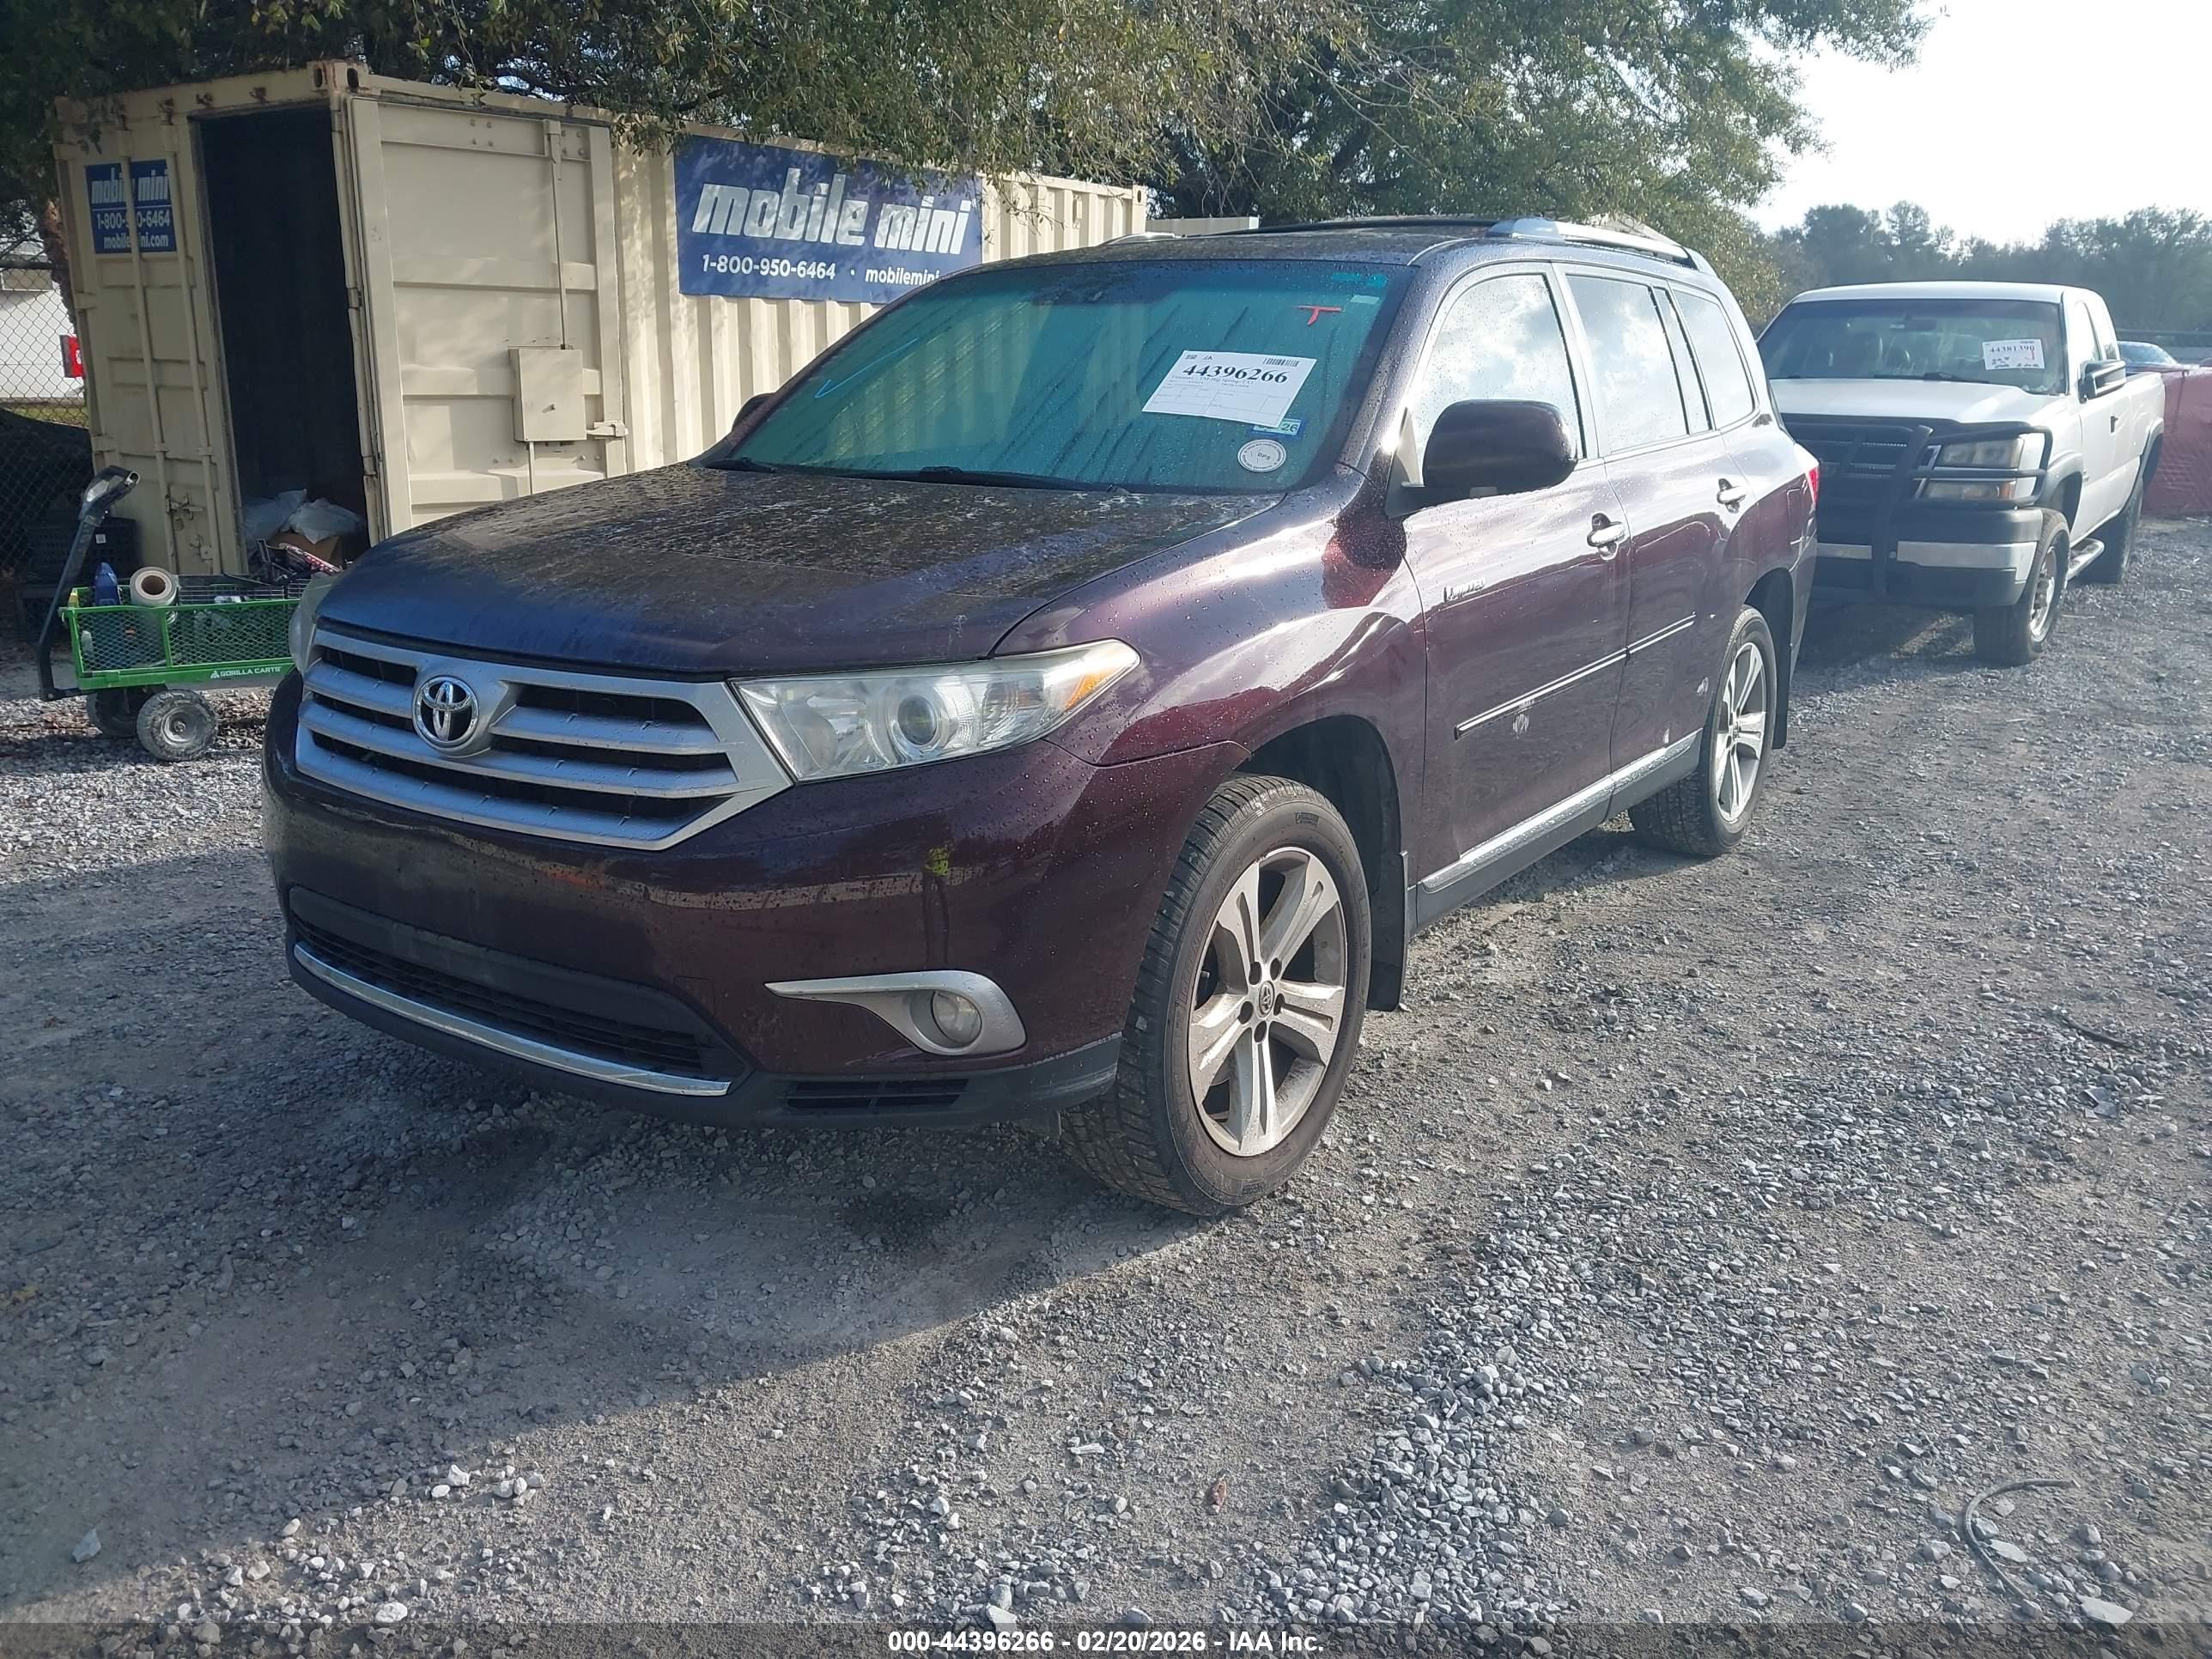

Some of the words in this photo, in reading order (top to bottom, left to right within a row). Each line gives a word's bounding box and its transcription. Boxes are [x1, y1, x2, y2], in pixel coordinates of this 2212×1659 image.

[137, 169, 169, 201] mini
[692, 167, 869, 246] mobile
[874, 195, 970, 254] mini
[702, 253, 836, 280] 1-800-950-6464
[1182, 364, 1291, 384] 44396266
[1281, 422, 1299, 432] 26
